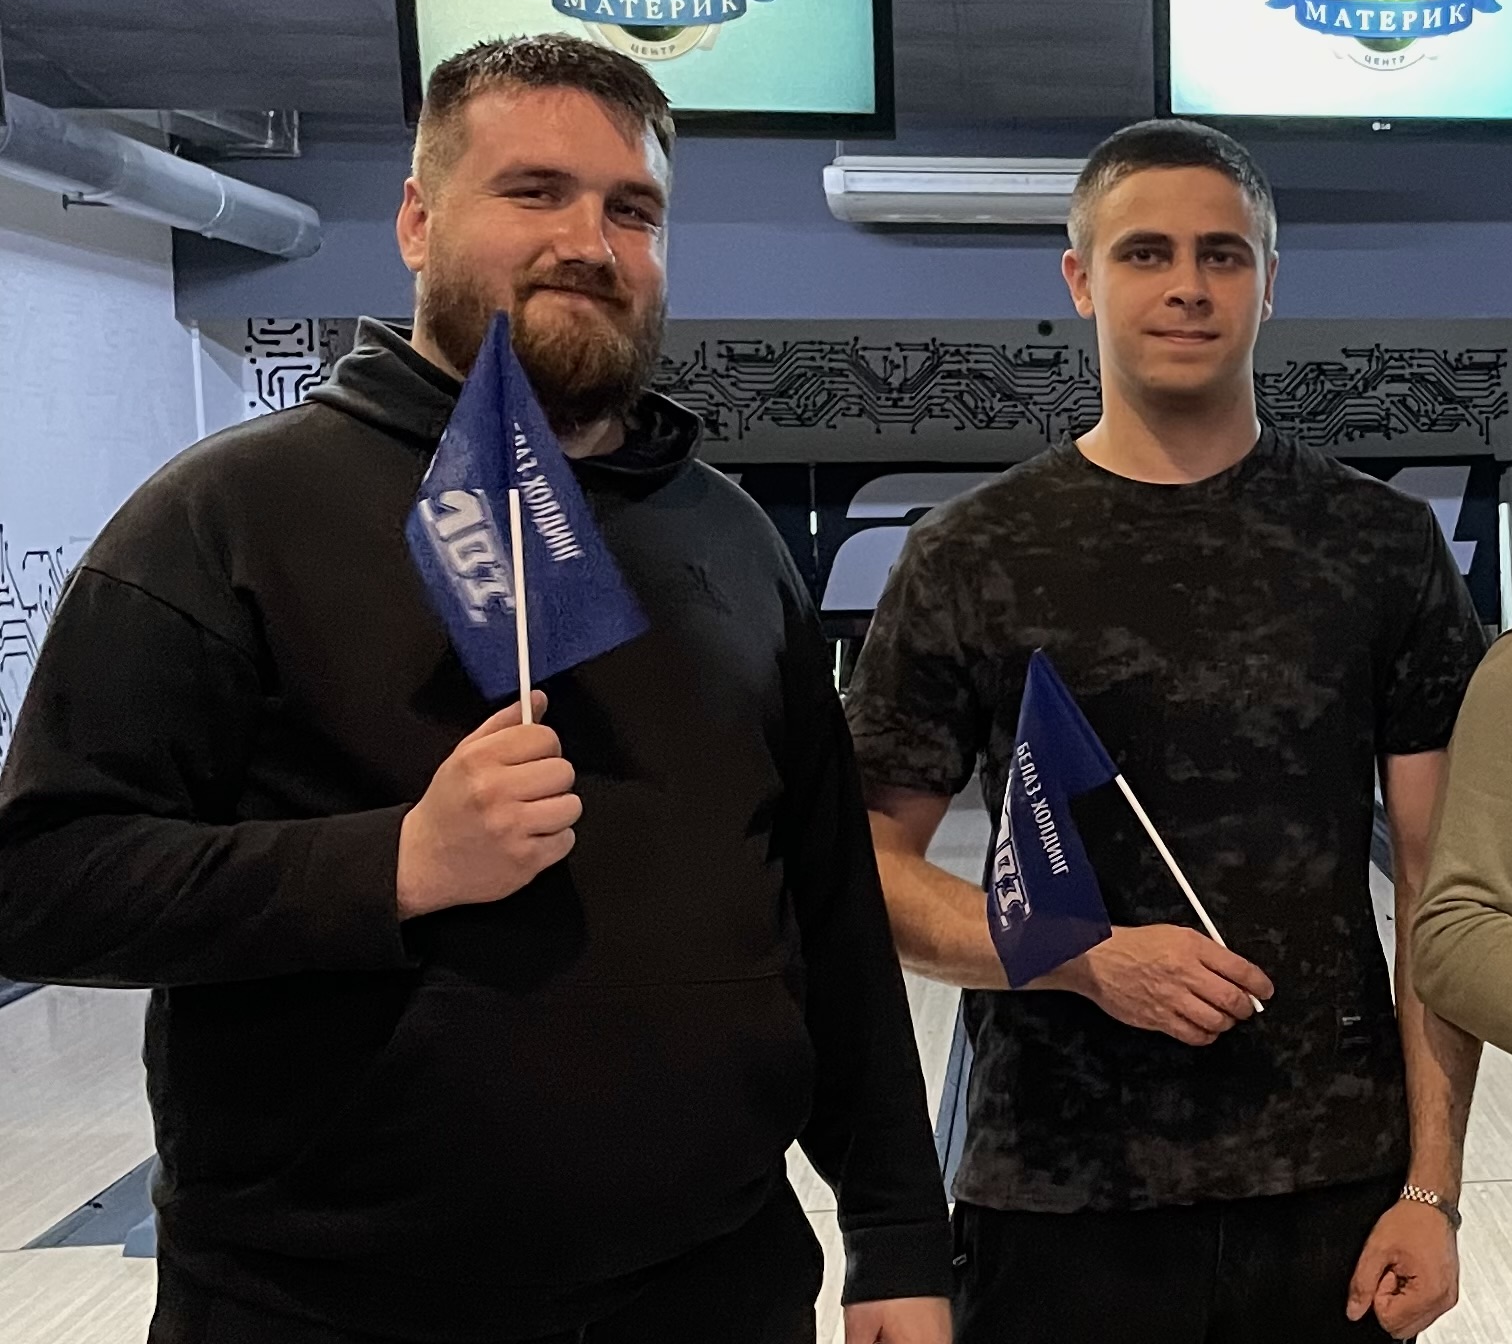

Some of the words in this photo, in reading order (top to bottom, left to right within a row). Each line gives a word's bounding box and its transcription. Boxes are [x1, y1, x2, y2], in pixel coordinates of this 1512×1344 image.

[1304, 0, 1467, 32] МАТЕРИК
[630, 43, 677, 56] ЦЕНТР
[1363, 54, 1406, 67] ЦЕНТР
[1015, 740, 1071, 876] БЕЛАЗ-ХОЛДИНГ
